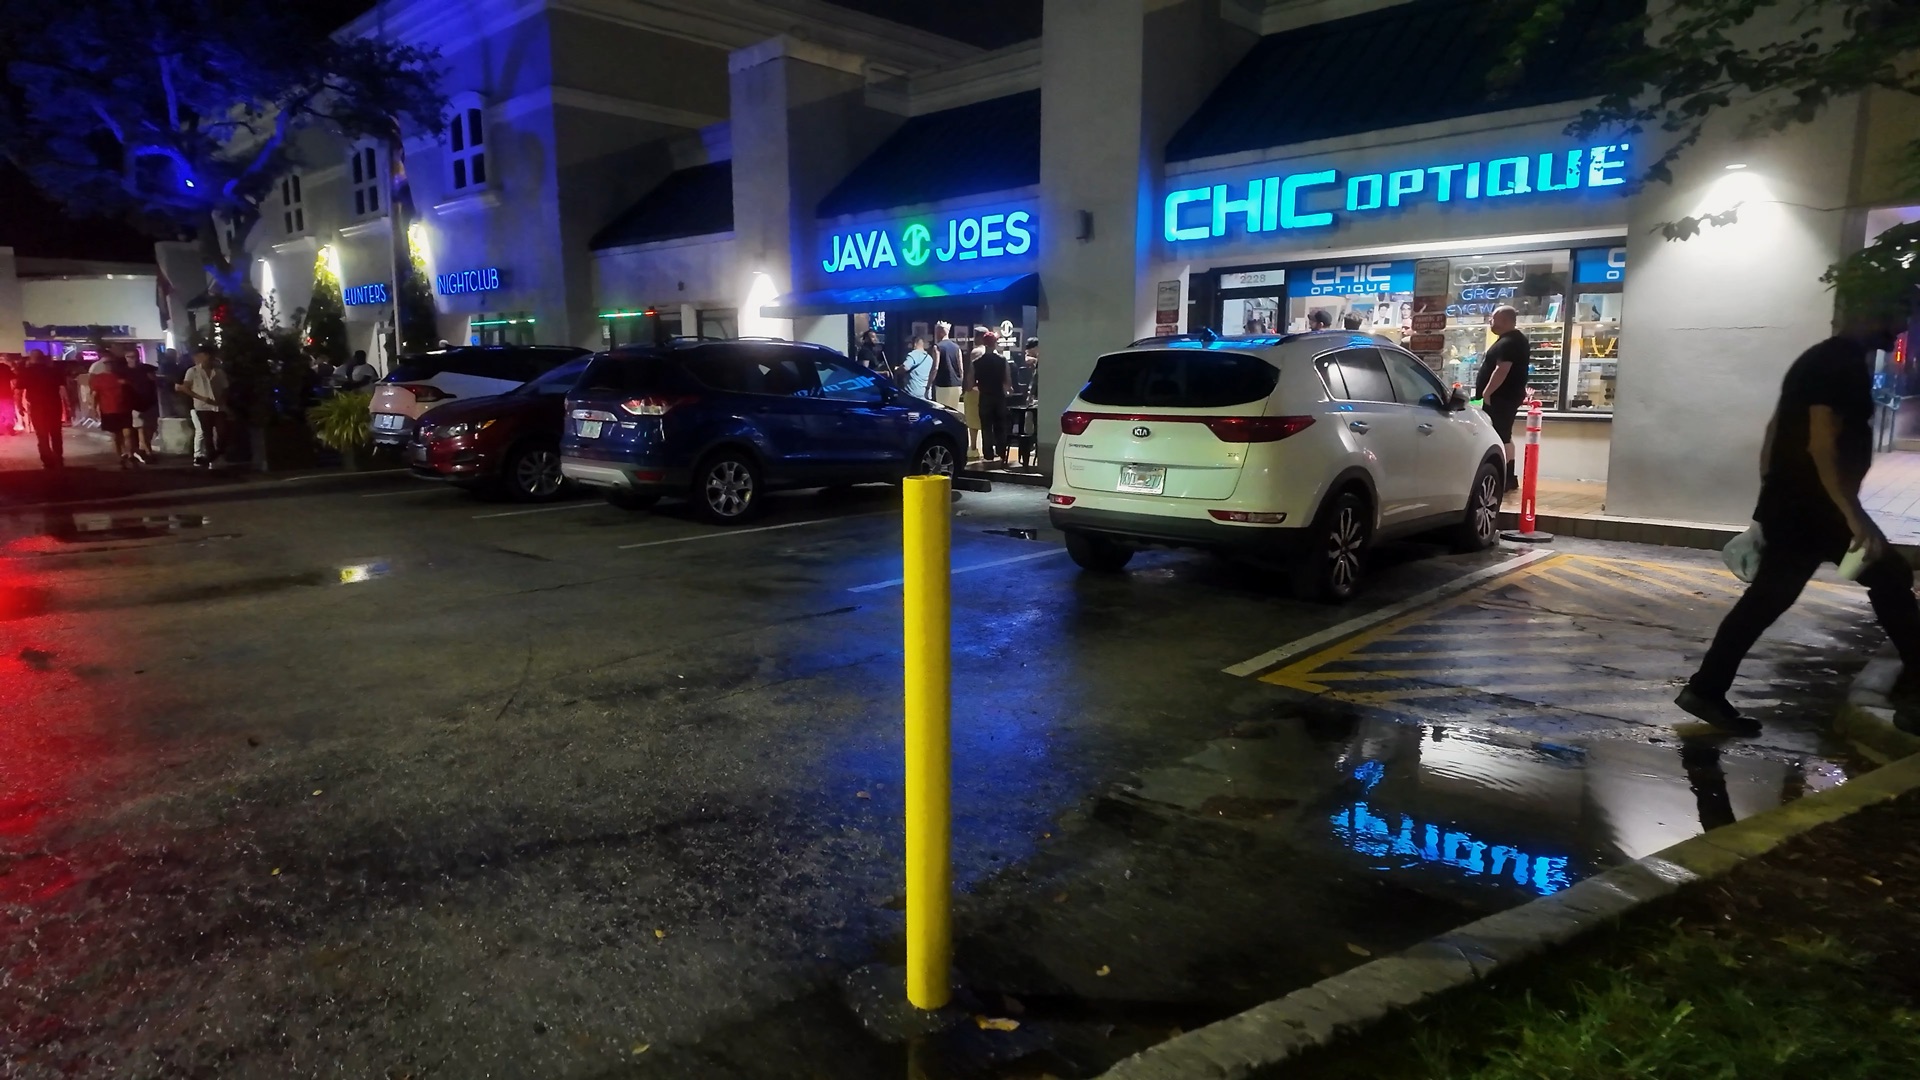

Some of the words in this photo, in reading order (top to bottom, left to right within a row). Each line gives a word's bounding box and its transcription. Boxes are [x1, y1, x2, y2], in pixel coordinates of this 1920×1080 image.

[1164, 168, 1337, 242] CHIC
[1346, 143, 1630, 212] OPTIQUE
[822, 230, 898, 273] JAVA
[935, 211, 1031, 262] JOES
[437, 268, 499, 295] NIGHTCLUB
[1239, 274, 1267, 284] 2228
[1311, 262, 1392, 286] CHIC
[1459, 259, 1523, 284] OPEN
[344, 283, 387, 306] HUNTERS
[1310, 282, 1390, 295] OPTIQUE
[1461, 286, 1518, 301] GREAT
[1445, 302, 1497, 317] EYEW
